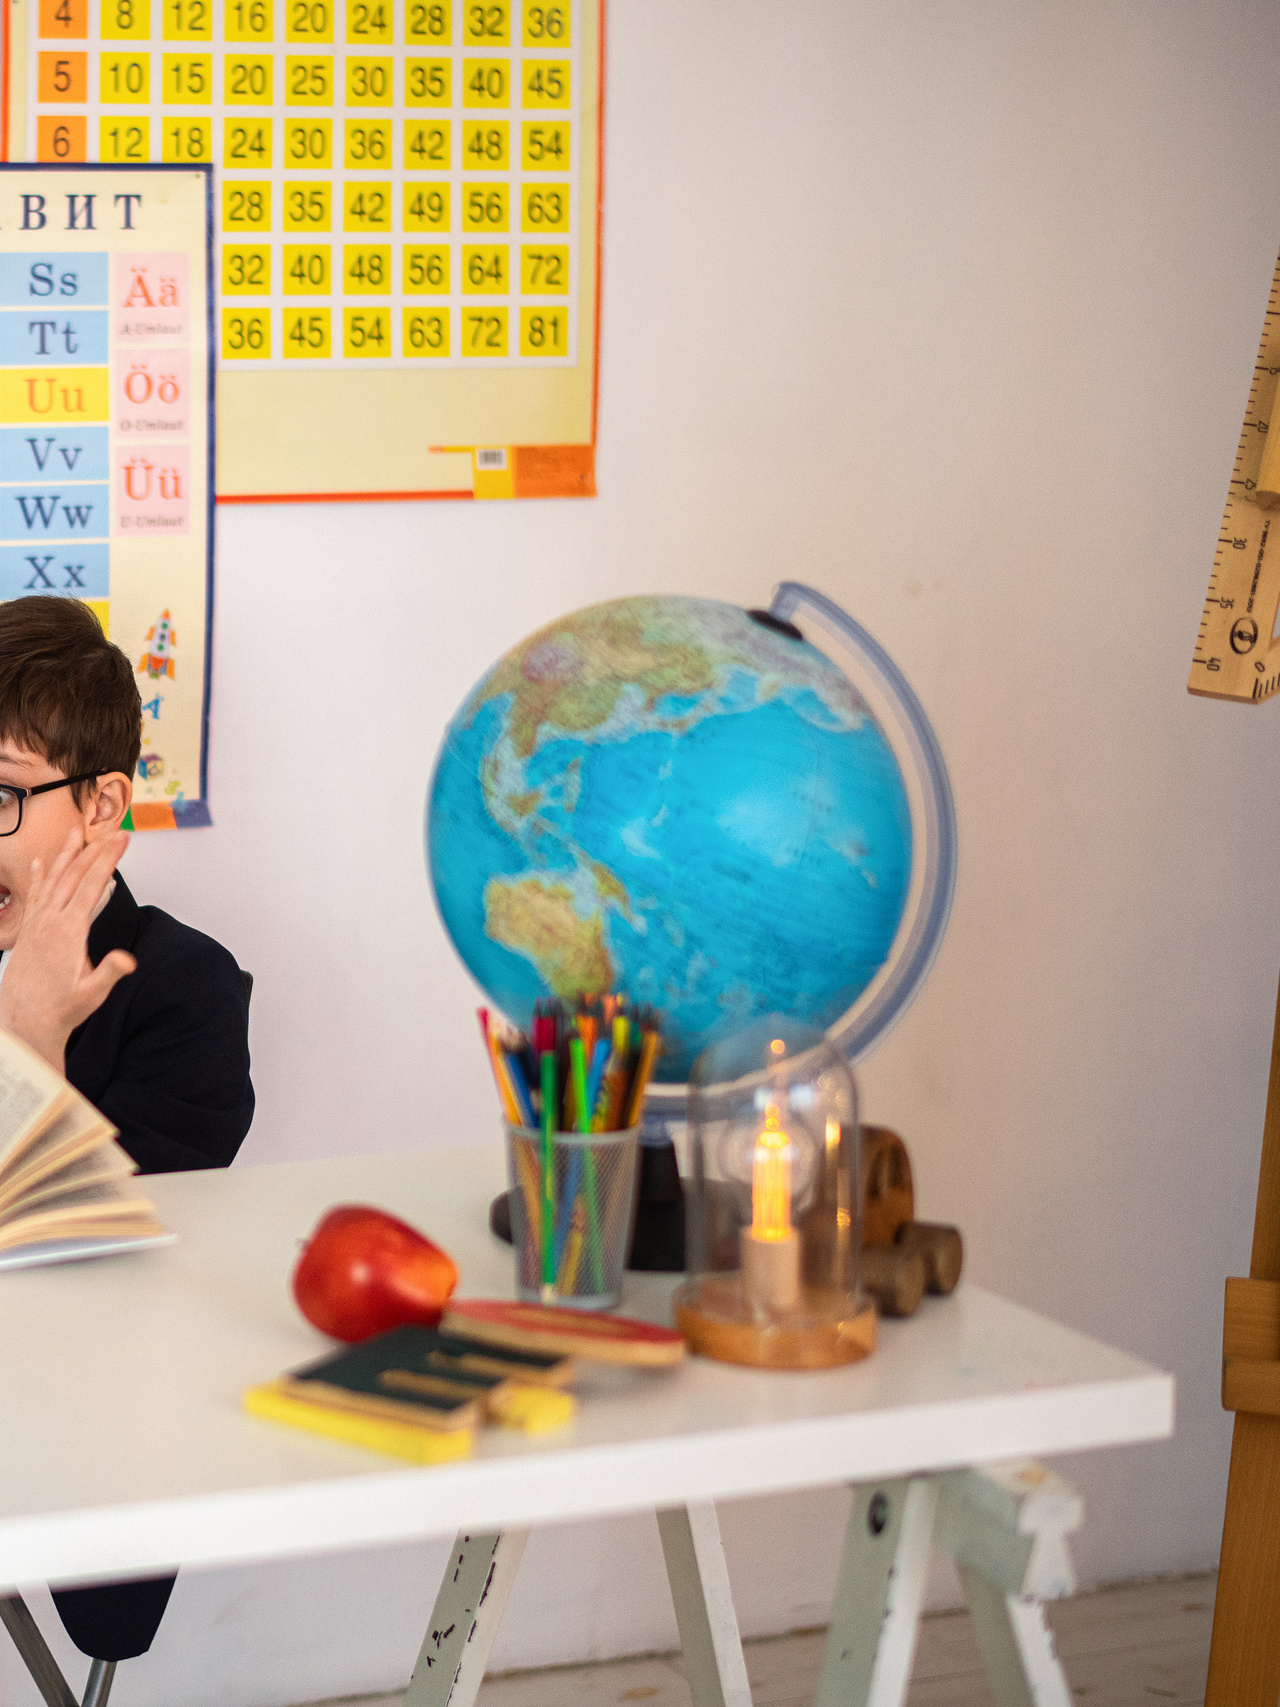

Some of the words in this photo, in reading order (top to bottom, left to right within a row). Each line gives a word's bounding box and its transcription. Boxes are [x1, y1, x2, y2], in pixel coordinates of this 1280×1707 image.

[54, 0, 73, 27] 4
[116, 0, 134, 31] 8
[172, 0, 205, 32] 12
[234, 0, 267, 33] 16
[292, 1, 326, 34] 20
[353, 3, 387, 35] 24
[411, 4, 444, 36] 28
[470, 5, 504, 37] 32
[528, 7, 563, 39] 36
[53, 59, 71, 93] 5
[109, 61, 144, 95] 10
[172, 61, 205, 95] 15
[231, 63, 266, 96] 20
[291, 64, 326, 97] 25
[352, 65, 387, 98] 30
[411, 66, 445, 98] 35
[469, 67, 503, 99] 40
[528, 67, 563, 100] 45
[52, 125, 71, 158] 6
[109, 126, 143, 159] 12
[171, 126, 205, 159] 18
[230, 127, 266, 159] 24
[291, 127, 325, 160] 30
[350, 128, 386, 161] 36
[410, 129, 444, 161] 42
[468, 129, 502, 161] 48
[528, 129, 563, 161] 54
[229, 190, 263, 223] 28
[289, 190, 325, 223] 35
[350, 191, 385, 223] 42
[409, 191, 444, 223] 49
[468, 191, 503, 224] 56
[527, 192, 563, 224] 63
[28, 262, 78, 297] Ss
[228, 253, 264, 286] 32
[289, 253, 324, 286] 40
[349, 254, 384, 286] 48
[409, 253, 443, 286] 56
[468, 254, 503, 286] 64
[528, 253, 563, 286] 72
[124, 268, 178, 308] Ää
[28, 320, 78, 356] Tt
[228, 317, 264, 350] 36
[289, 316, 324, 349] 45
[350, 315, 385, 348] 54
[409, 316, 444, 349] 63
[469, 315, 502, 348] 72
[528, 315, 559, 348] 81
[24, 377, 85, 414] Uu
[123, 364, 180, 404] Öö
[25, 436, 83, 472] Vv
[123, 458, 182, 501] Üü
[15, 495, 93, 530] Ww
[1232, 537, 1247, 550] 30
[24, 555, 86, 590] Xx
[1220, 597, 1234, 609] 35
[1206, 657, 1221, 672] 40
